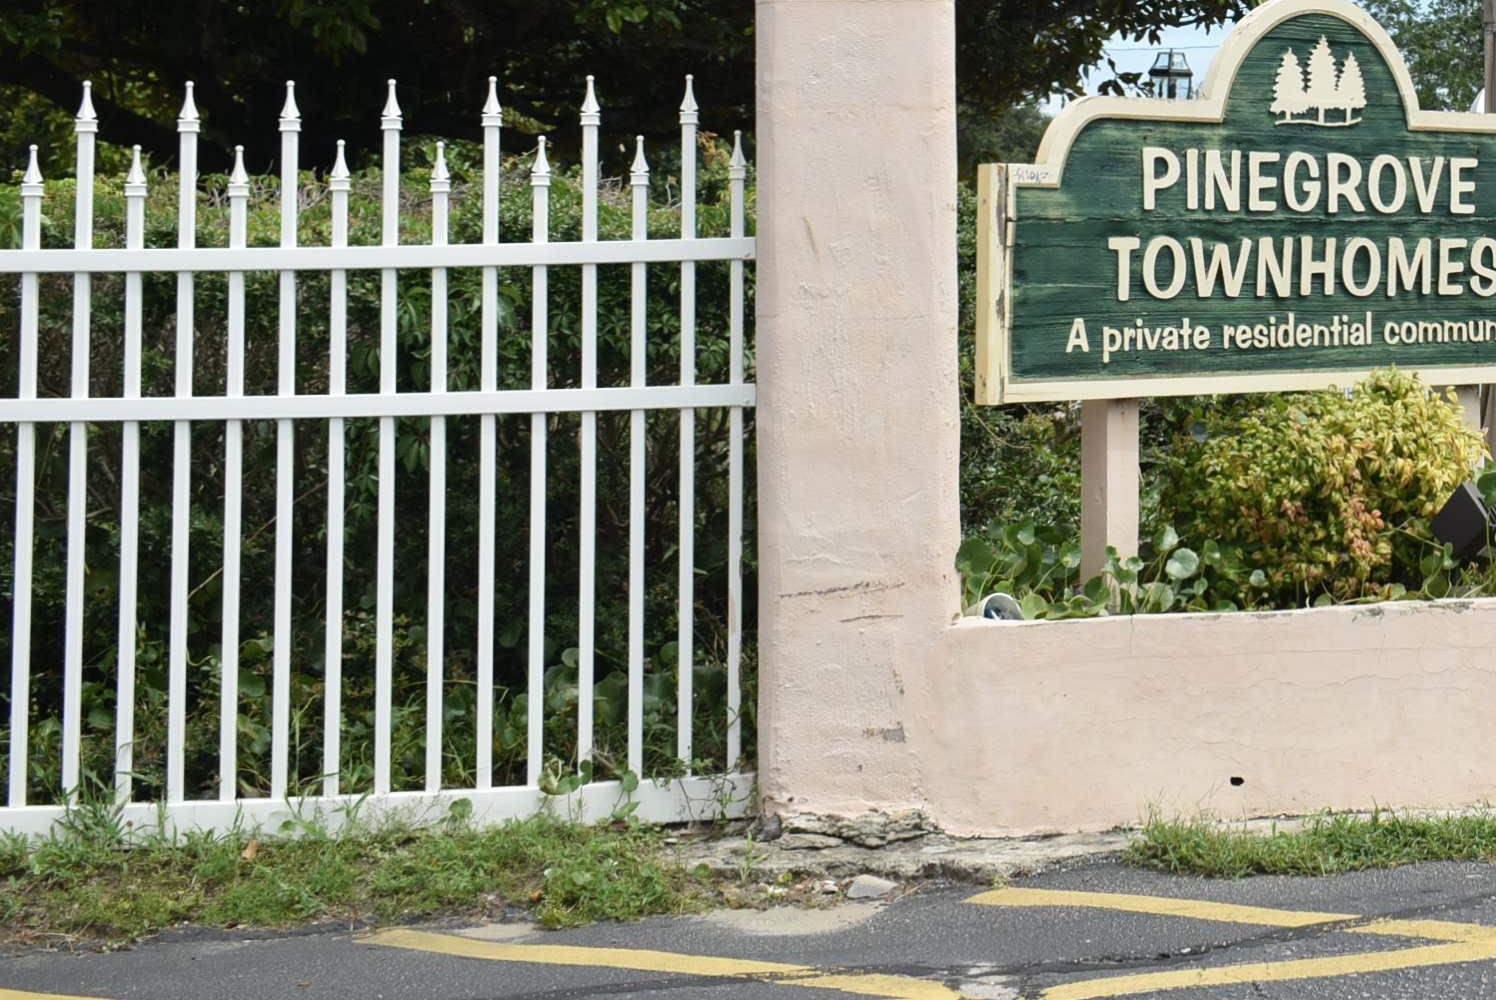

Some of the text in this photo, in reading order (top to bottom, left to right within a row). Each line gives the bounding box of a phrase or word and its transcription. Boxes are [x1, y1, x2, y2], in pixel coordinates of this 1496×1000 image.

[1142, 146, 1479, 215] PINEGROVE
[1065, 317, 1090, 353] A
[1103, 317, 1211, 364] private
[1223, 311, 1373, 350] residential
